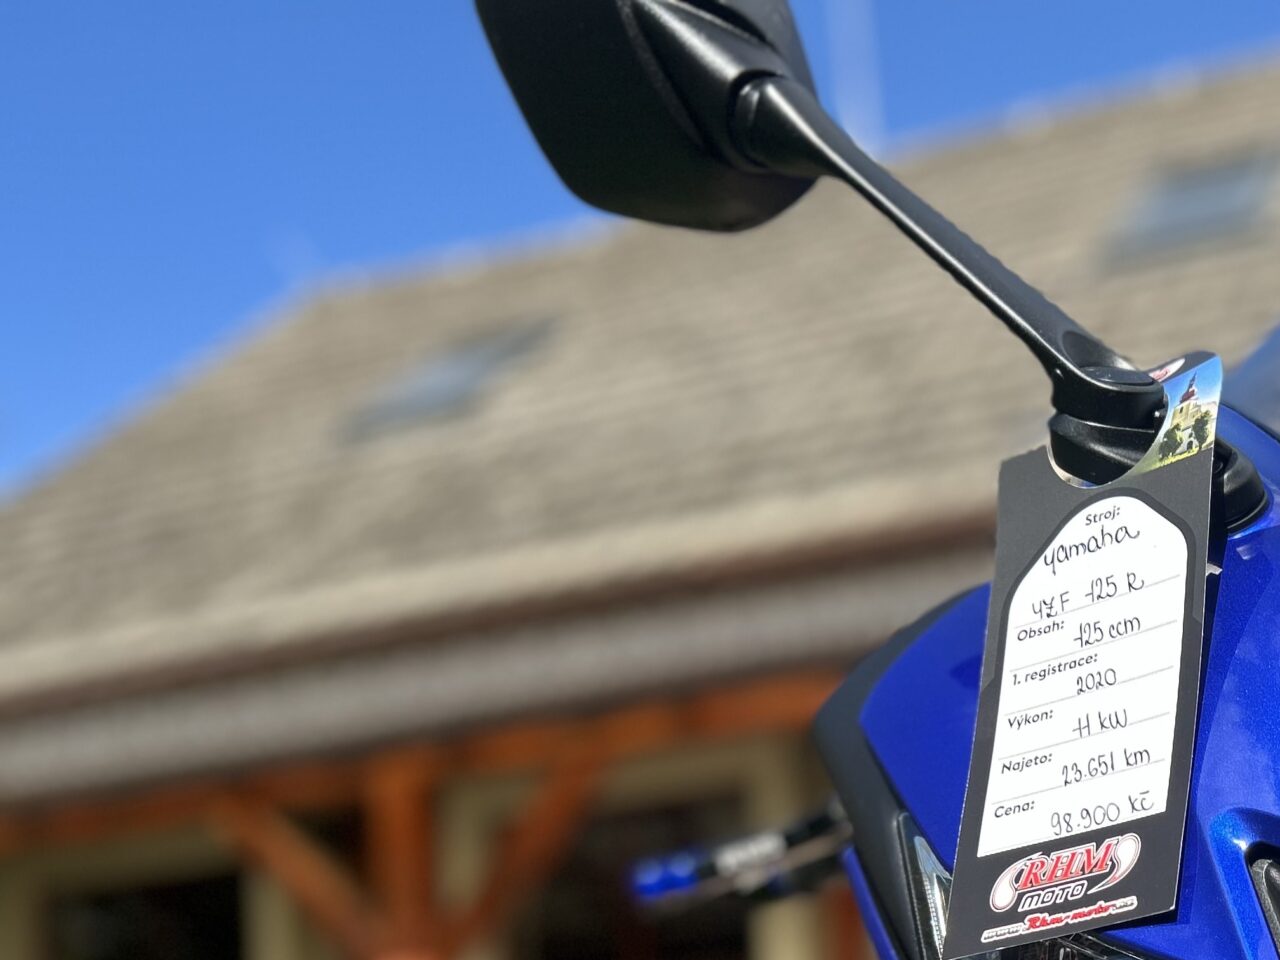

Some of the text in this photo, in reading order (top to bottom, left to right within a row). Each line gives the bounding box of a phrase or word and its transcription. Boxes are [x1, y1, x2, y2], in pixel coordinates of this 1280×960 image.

[1085, 505, 1121, 526] Stroj:
[1085, 575, 1118, 604] 125
[1126, 571, 1145, 593] R
[1016, 616, 1141, 649] Obsah: 125 ccm
[1012, 653, 1117, 695] 1. registrace: 2020
[1008, 709, 1053, 731] Výkon:
[1001, 748, 1150, 787] Najeto: 23.651 km
[994, 801, 1034, 819] Cena:
[1050, 802, 1120, 837] 98.900
[1019, 840, 1117, 891] RHM
